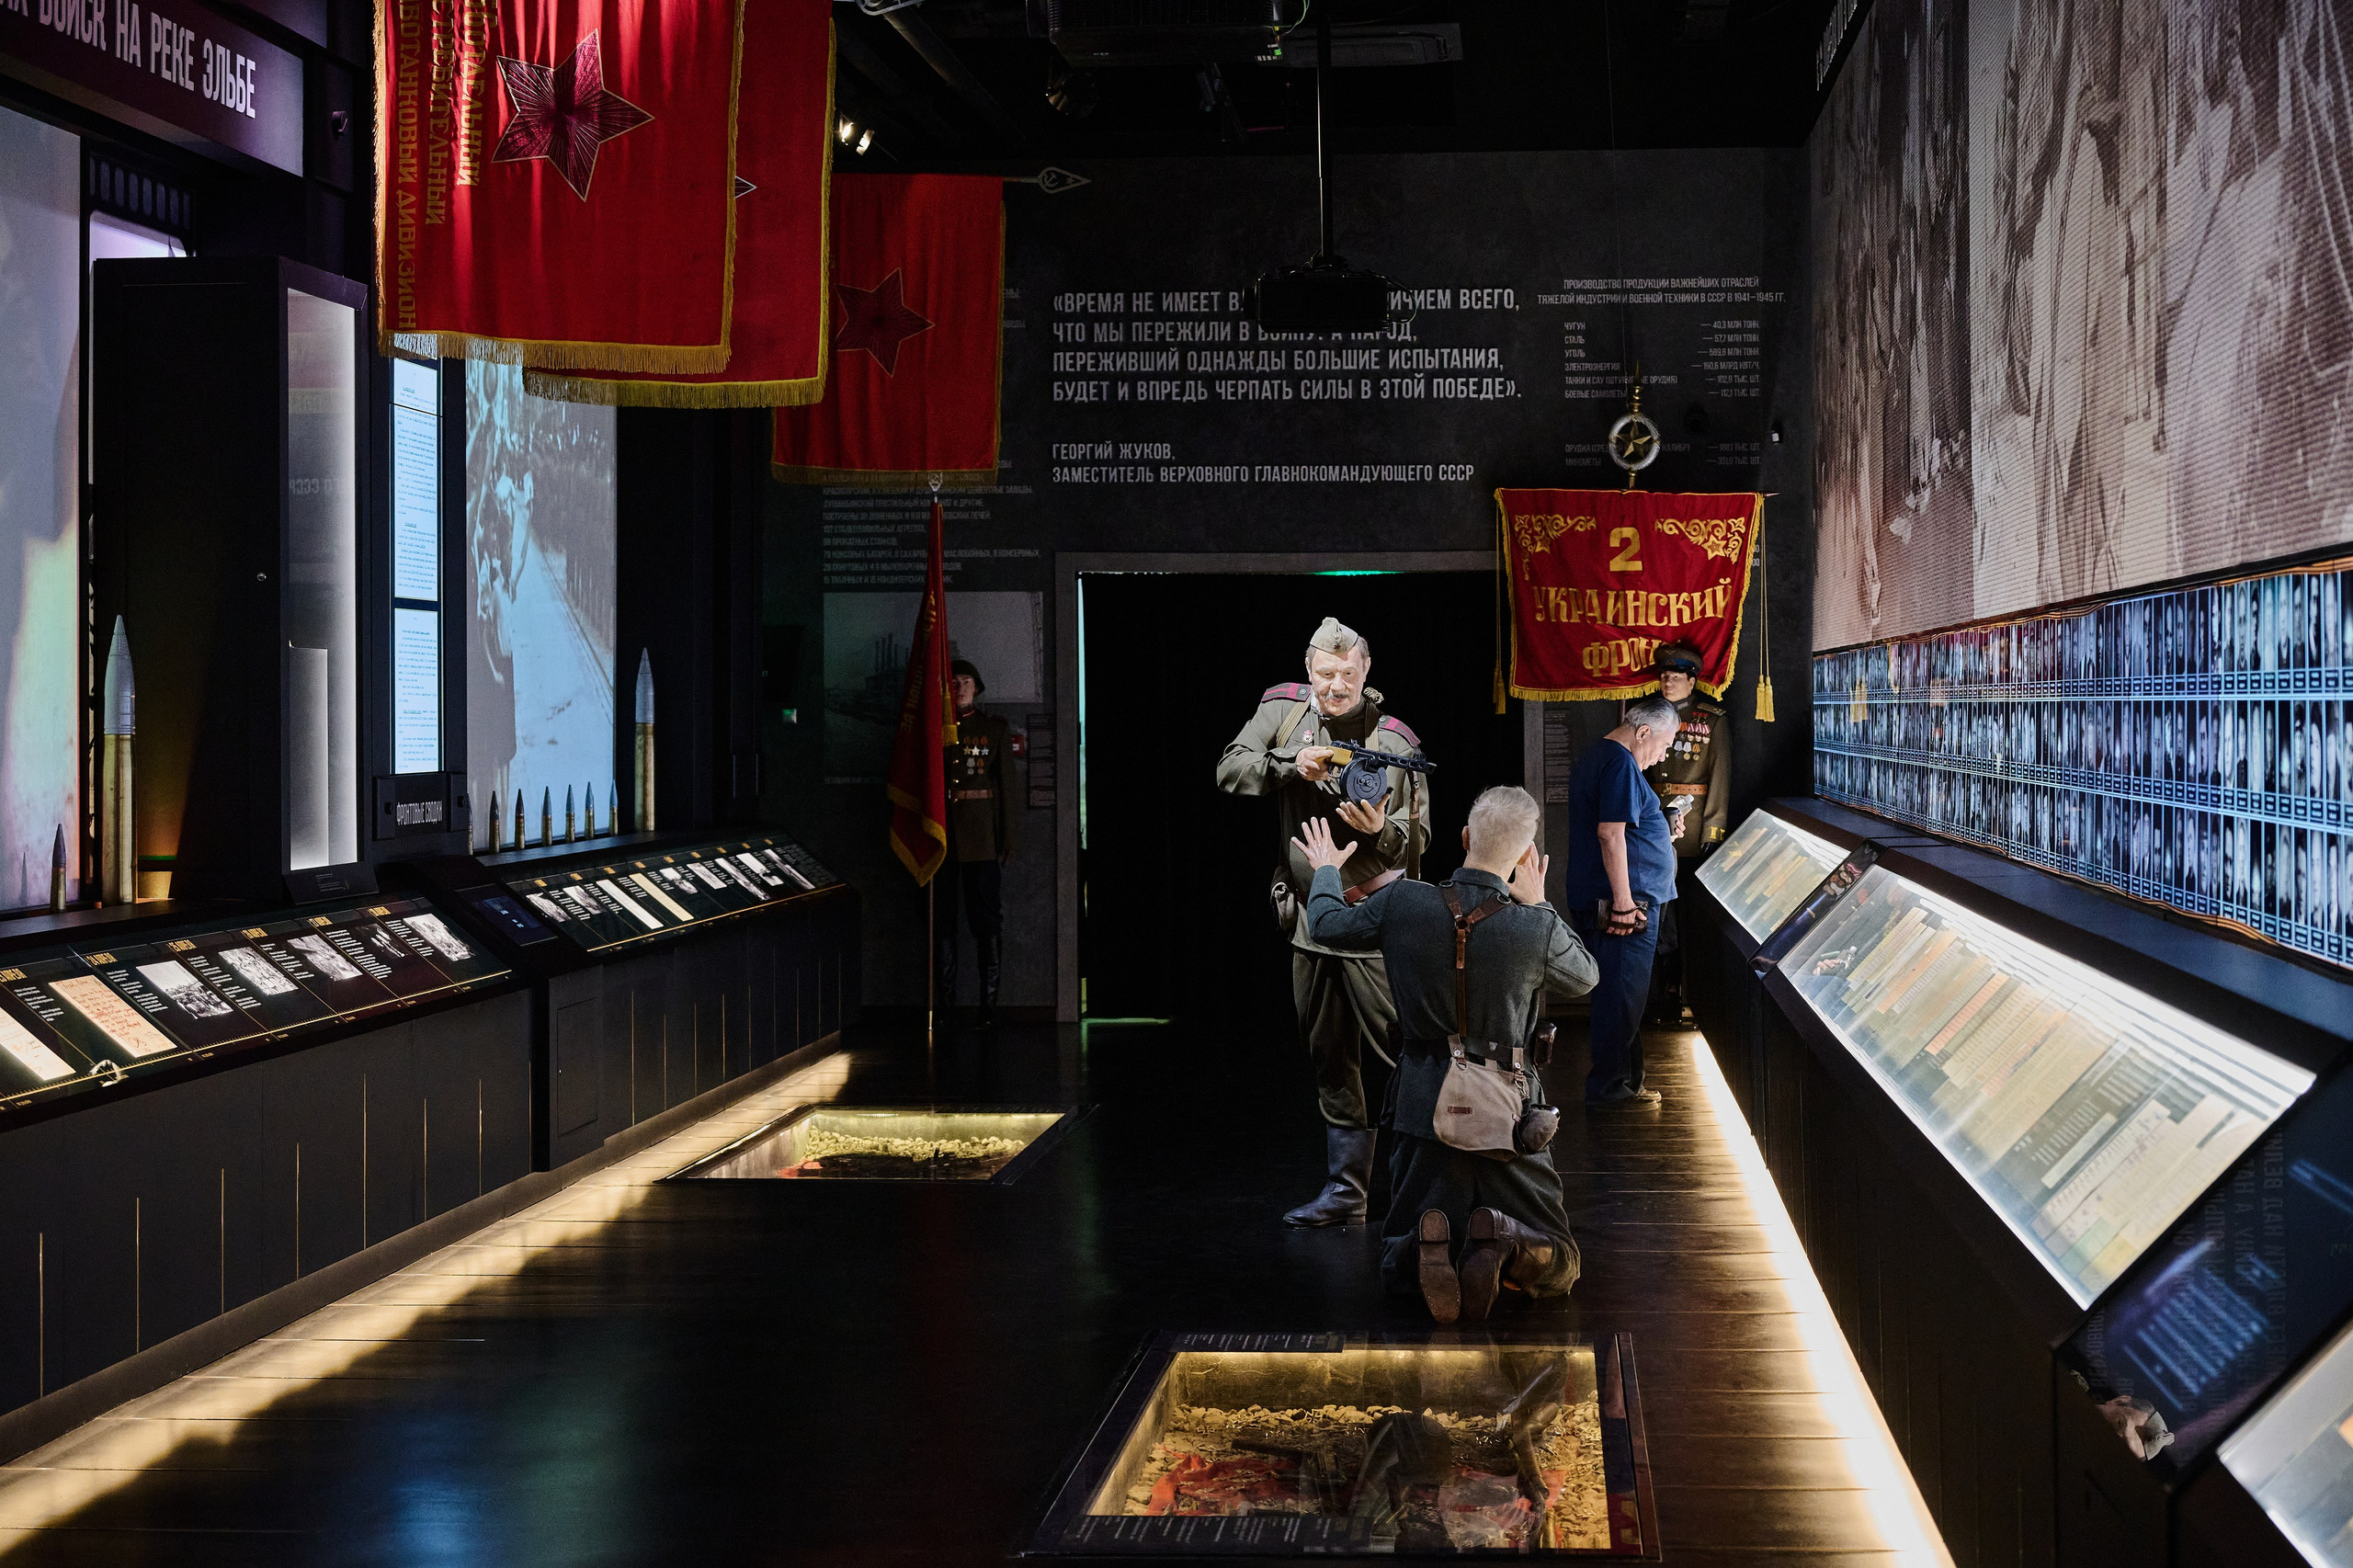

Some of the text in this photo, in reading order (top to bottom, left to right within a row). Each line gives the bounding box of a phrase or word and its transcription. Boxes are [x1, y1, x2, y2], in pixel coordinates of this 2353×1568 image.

[115, 0, 142, 68] НА
[150, 12, 196, 92] РЕКЕ
[202, 39, 256, 119] ЭЛЬБЕ
[395, 0, 421, 328] ВОТАНКОВЫЙ ДИВИЗИОН
[1564, 276, 1758, 290] ПРОИЗВОДСТВО ПРОДУКЦИИ ВАЖНЕЙШИХ ОТРАСЛЕЙ
[1053, 291, 1124, 312] «ВРЕМЯ
[1132, 291, 1154, 312] НЕ
[1162, 290, 1220, 312] ИМЕЕТ
[1391, 289, 1520, 312] ИЧИЕМ ВСЕГО,
[1538, 293, 1574, 304] ТЯЖЕЛОЙ
[1576, 294, 1620, 304] ИНДУСТРИИ
[1622, 294, 1627, 303] И
[1630, 292, 1663, 303] ВОЕННОЙ
[1665, 293, 1699, 303] ТЕХНИКИ
[1700, 293, 1705, 302] В
[1708, 293, 1725, 302] СССР
[1728, 292, 1732, 301] В
[1775, 292, 1786, 302] ГГ.
[1053, 323, 1086, 342] ЧТО
[1094, 322, 1124, 342] МЫ
[1132, 322, 1231, 342] ПЕРЕЖИЛИ
[1239, 322, 1249, 341] В
[1564, 322, 1586, 331] ЧУГУН
[1564, 335, 1585, 344] СТАЛЬ
[1053, 347, 1504, 372] ПЕРЕЖИВШИЙ ОДНАЖДЫ БОЛЬШИЕ ИСПЫТАНИЯ,
[1564, 349, 1586, 358] УГОЛЬ
[1728, 347, 1741, 357] МЛН
[1564, 362, 1620, 371] ЭЛЕКТРОЭНЕРГИЯ
[1053, 373, 1521, 403] БУДЕТ И ВПРЕДЬ ЧЕРПАТЬ СИЛЫ В ЭТОЙ ПОБЕДЕ».
[1566, 376, 1585, 384] ТАНКИ
[1586, 376, 1590, 384] И
[1592, 376, 1604, 384] САУ
[1565, 389, 1627, 398] БОЕВЫЕ САМОЛЕТЫ
[1052, 440, 1175, 461] ГЕОРГИЙ ЖУКОВ,
[1052, 465, 1473, 483] ЗАМЕСТИТЕЛЬ ВЕРХОВНОГО ГЛАВНОКОМАНДУЮЩЕГО СССР
[1608, 527, 1643, 572] 2
[1532, 577, 1733, 627] УКРАИНСКИЙ
[1582, 636, 1659, 677] ФРОН
